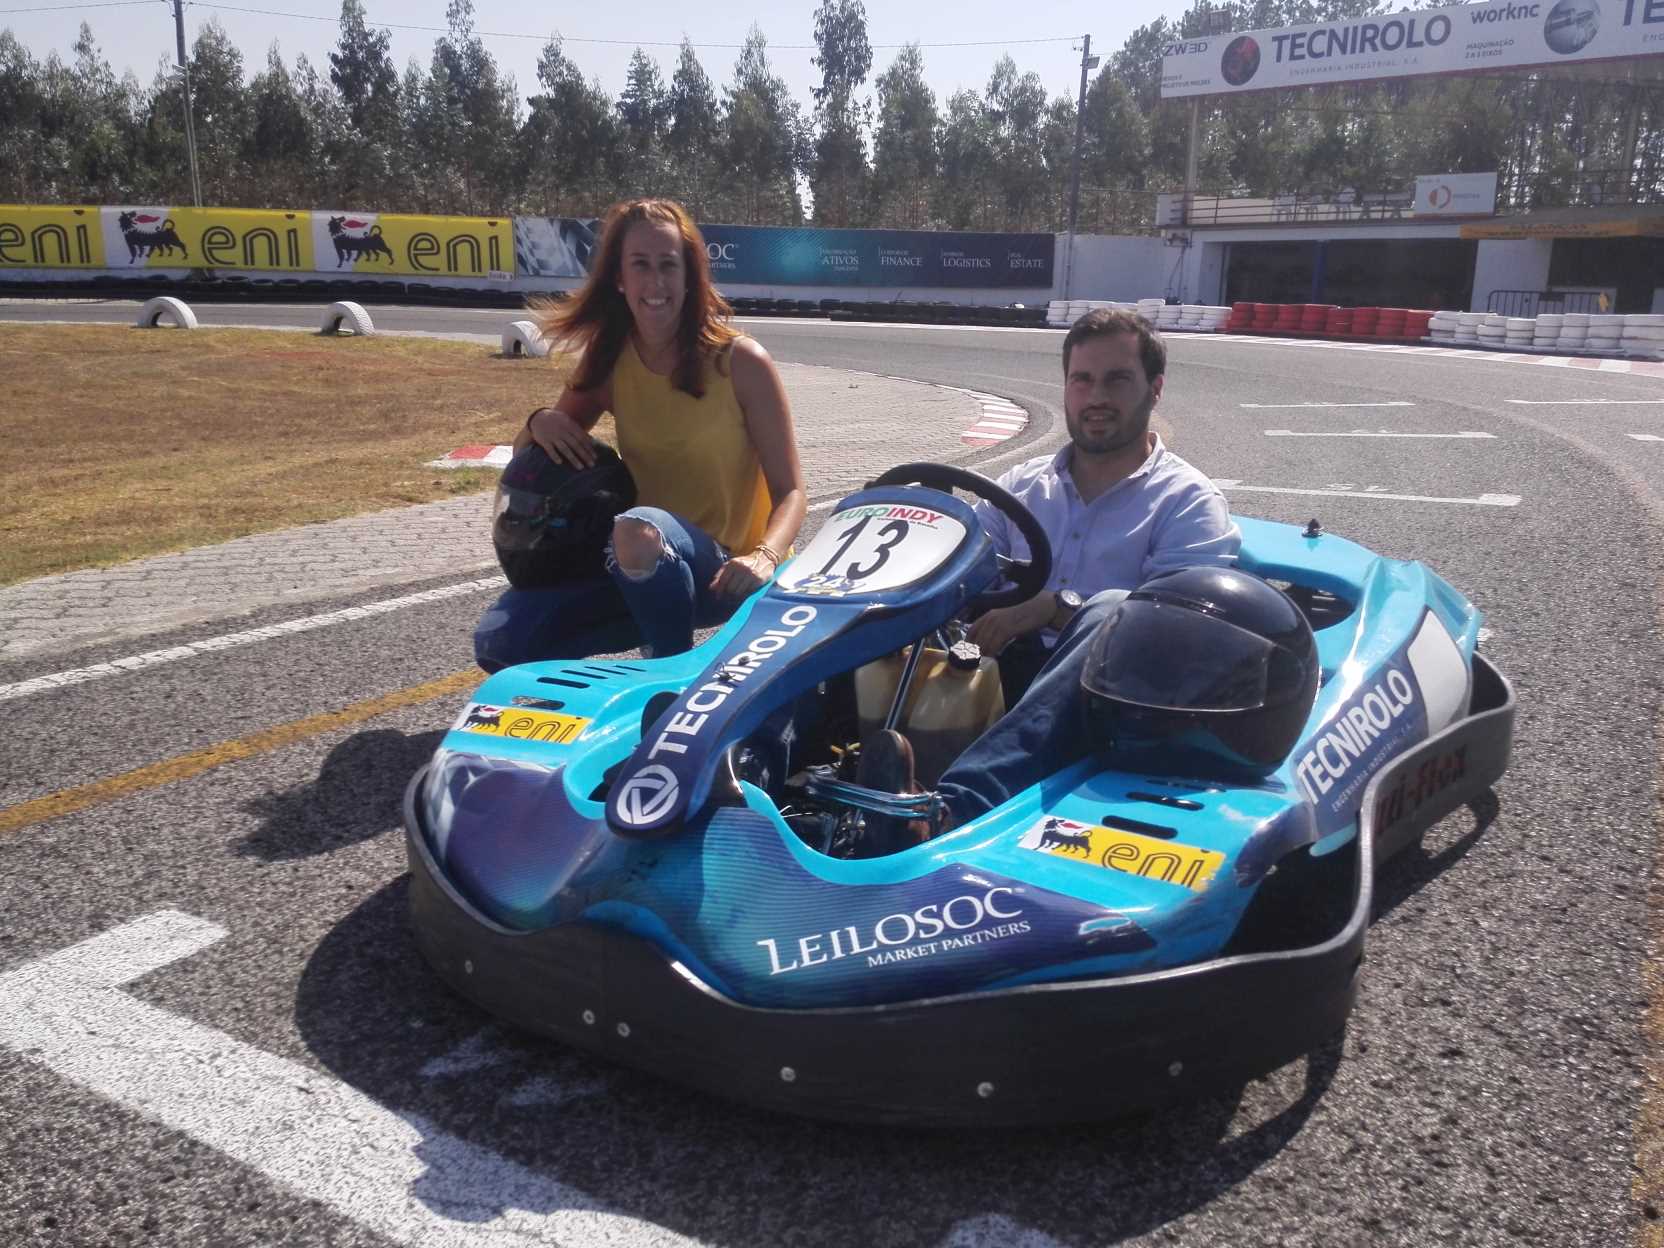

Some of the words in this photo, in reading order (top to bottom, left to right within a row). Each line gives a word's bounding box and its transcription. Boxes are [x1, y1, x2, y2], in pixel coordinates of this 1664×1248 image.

[1470, 3, 1540, 25] worknc
[1272, 15, 1452, 63] TECNIROLO
[0, 209, 91, 264] eni
[202, 213, 300, 267] eni
[408, 221, 500, 273] eni
[881, 256, 922, 267] FINANCE
[943, 258, 992, 268] LOGISTICS
[1010, 259, 1044, 269] ESTATE
[819, 515, 910, 580] 13
[505, 716, 582, 744] eni
[1297, 669, 1414, 804] TECNIROLO
[1101, 841, 1211, 889] eni
[757, 887, 1022, 975] LEILOSOC
[868, 942, 939, 967] MARKET
[942, 920, 1031, 951] PARTNERS
